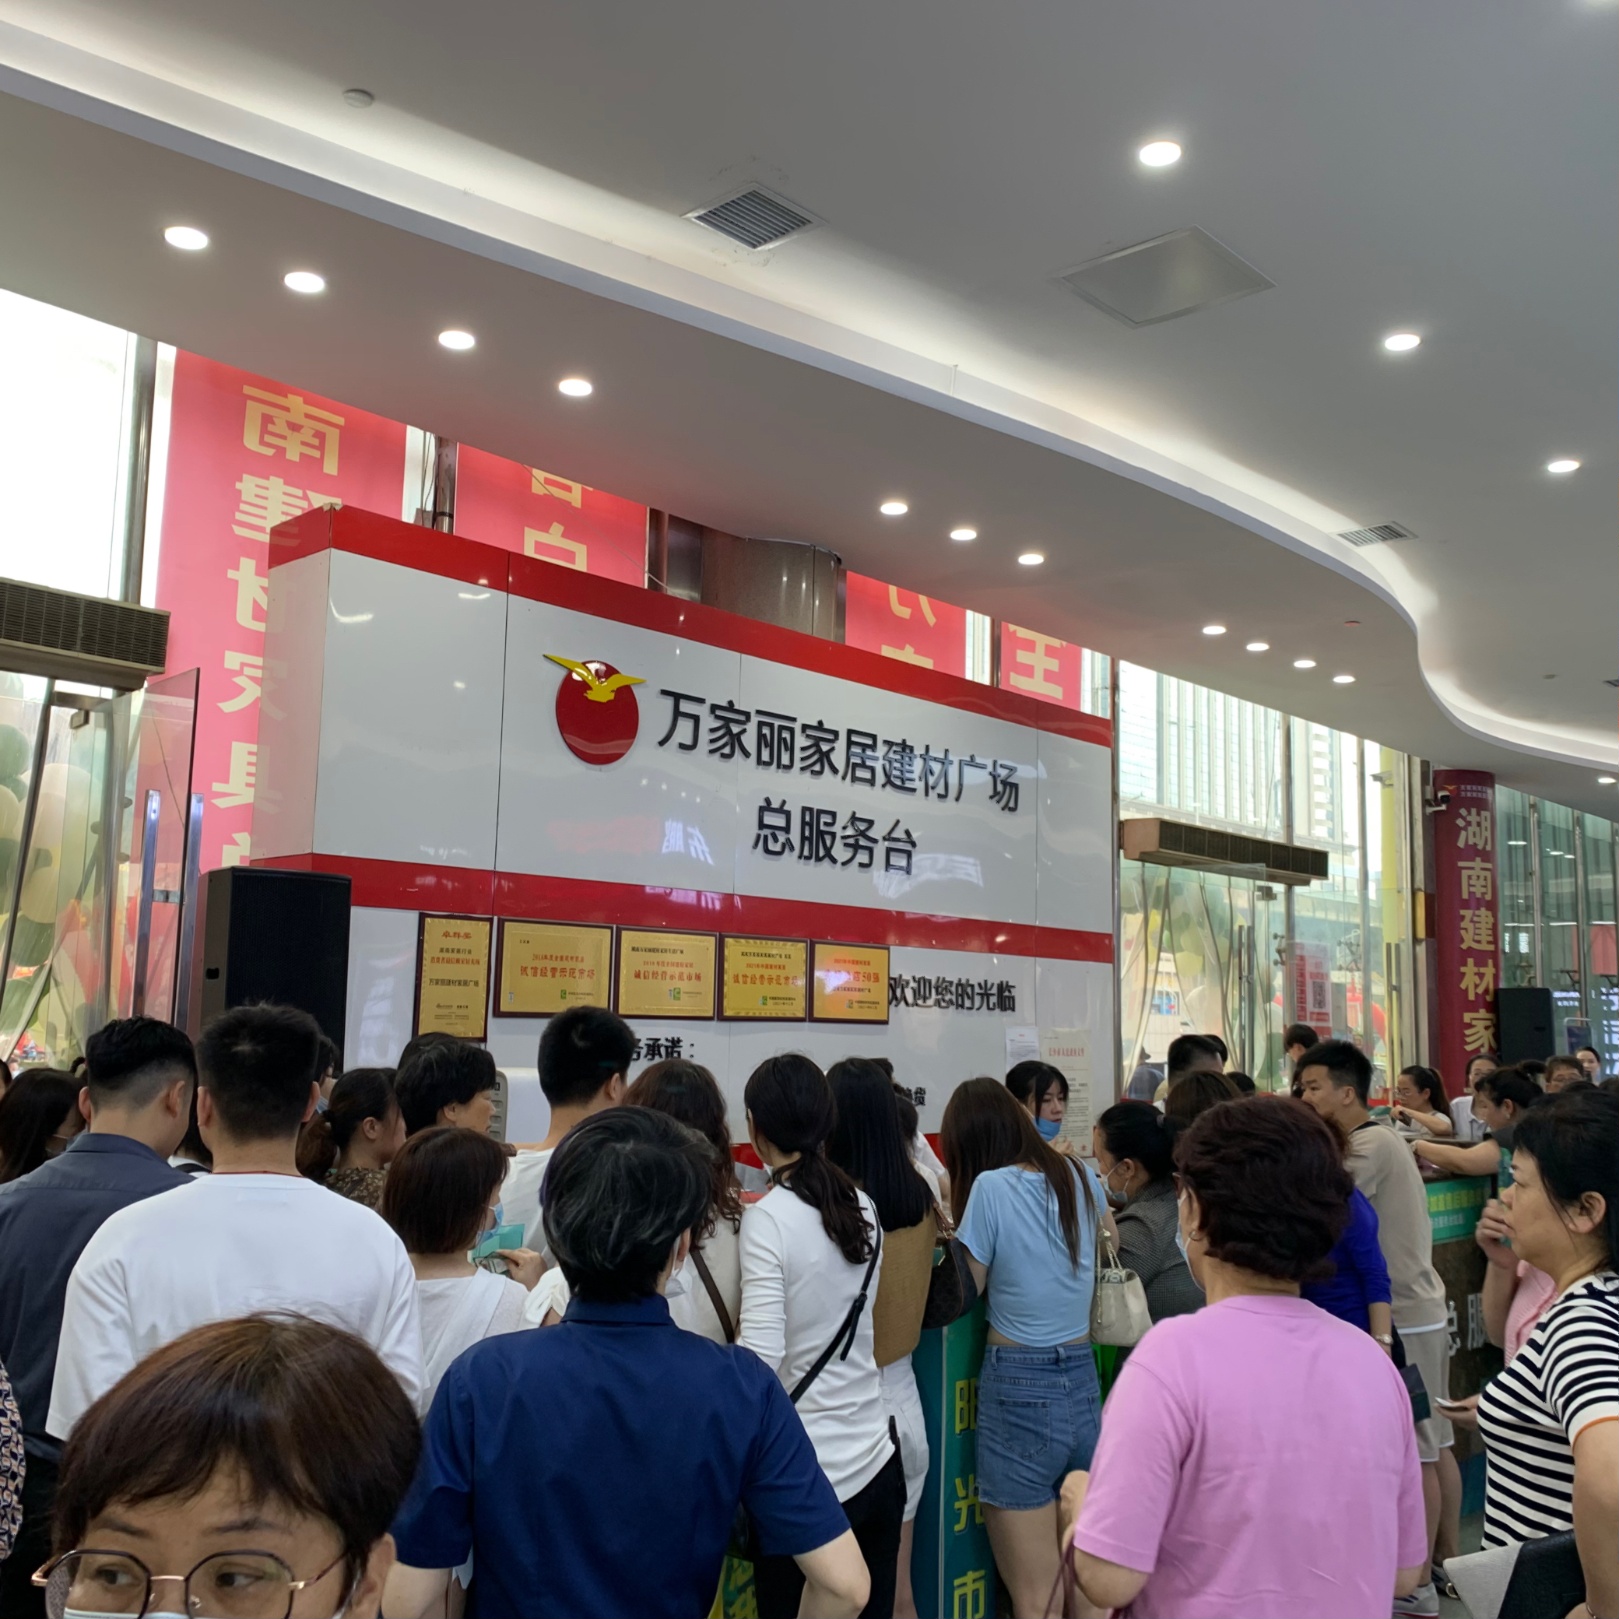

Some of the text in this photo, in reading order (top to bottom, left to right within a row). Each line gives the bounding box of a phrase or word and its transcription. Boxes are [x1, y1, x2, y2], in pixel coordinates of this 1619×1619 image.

[657, 687, 1021, 813] 万家丽家居建材广场
[752, 795, 919, 876] 总服务台
[1455, 807, 1497, 1053] 湖南建材家
[887, 974, 1018, 1014] 欢迎您的光临
